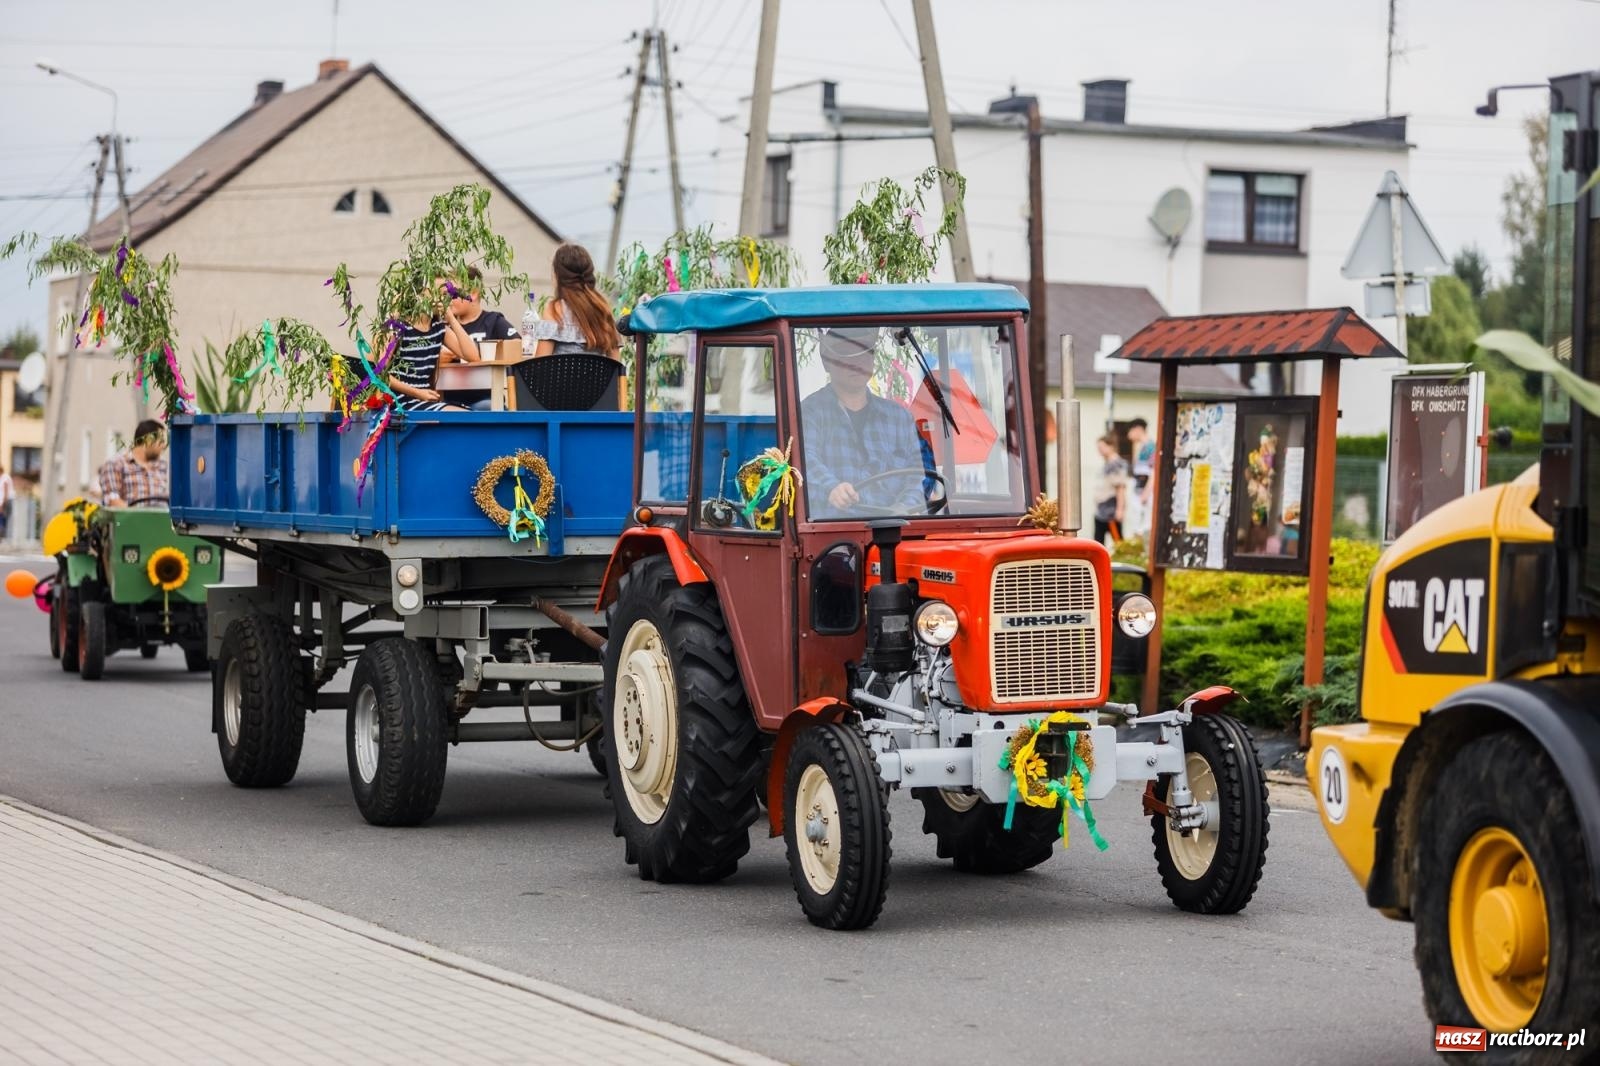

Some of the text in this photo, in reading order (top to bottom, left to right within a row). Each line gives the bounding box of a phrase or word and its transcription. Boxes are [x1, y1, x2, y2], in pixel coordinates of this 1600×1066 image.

[1411, 385, 1425, 397] DFK
[1411, 400, 1424, 412] DFK
[923, 569, 954, 582] URSUS
[1006, 614, 1086, 627] URSUS
[1423, 577, 1485, 654] CAT
[1324, 765, 1342, 805] 20
